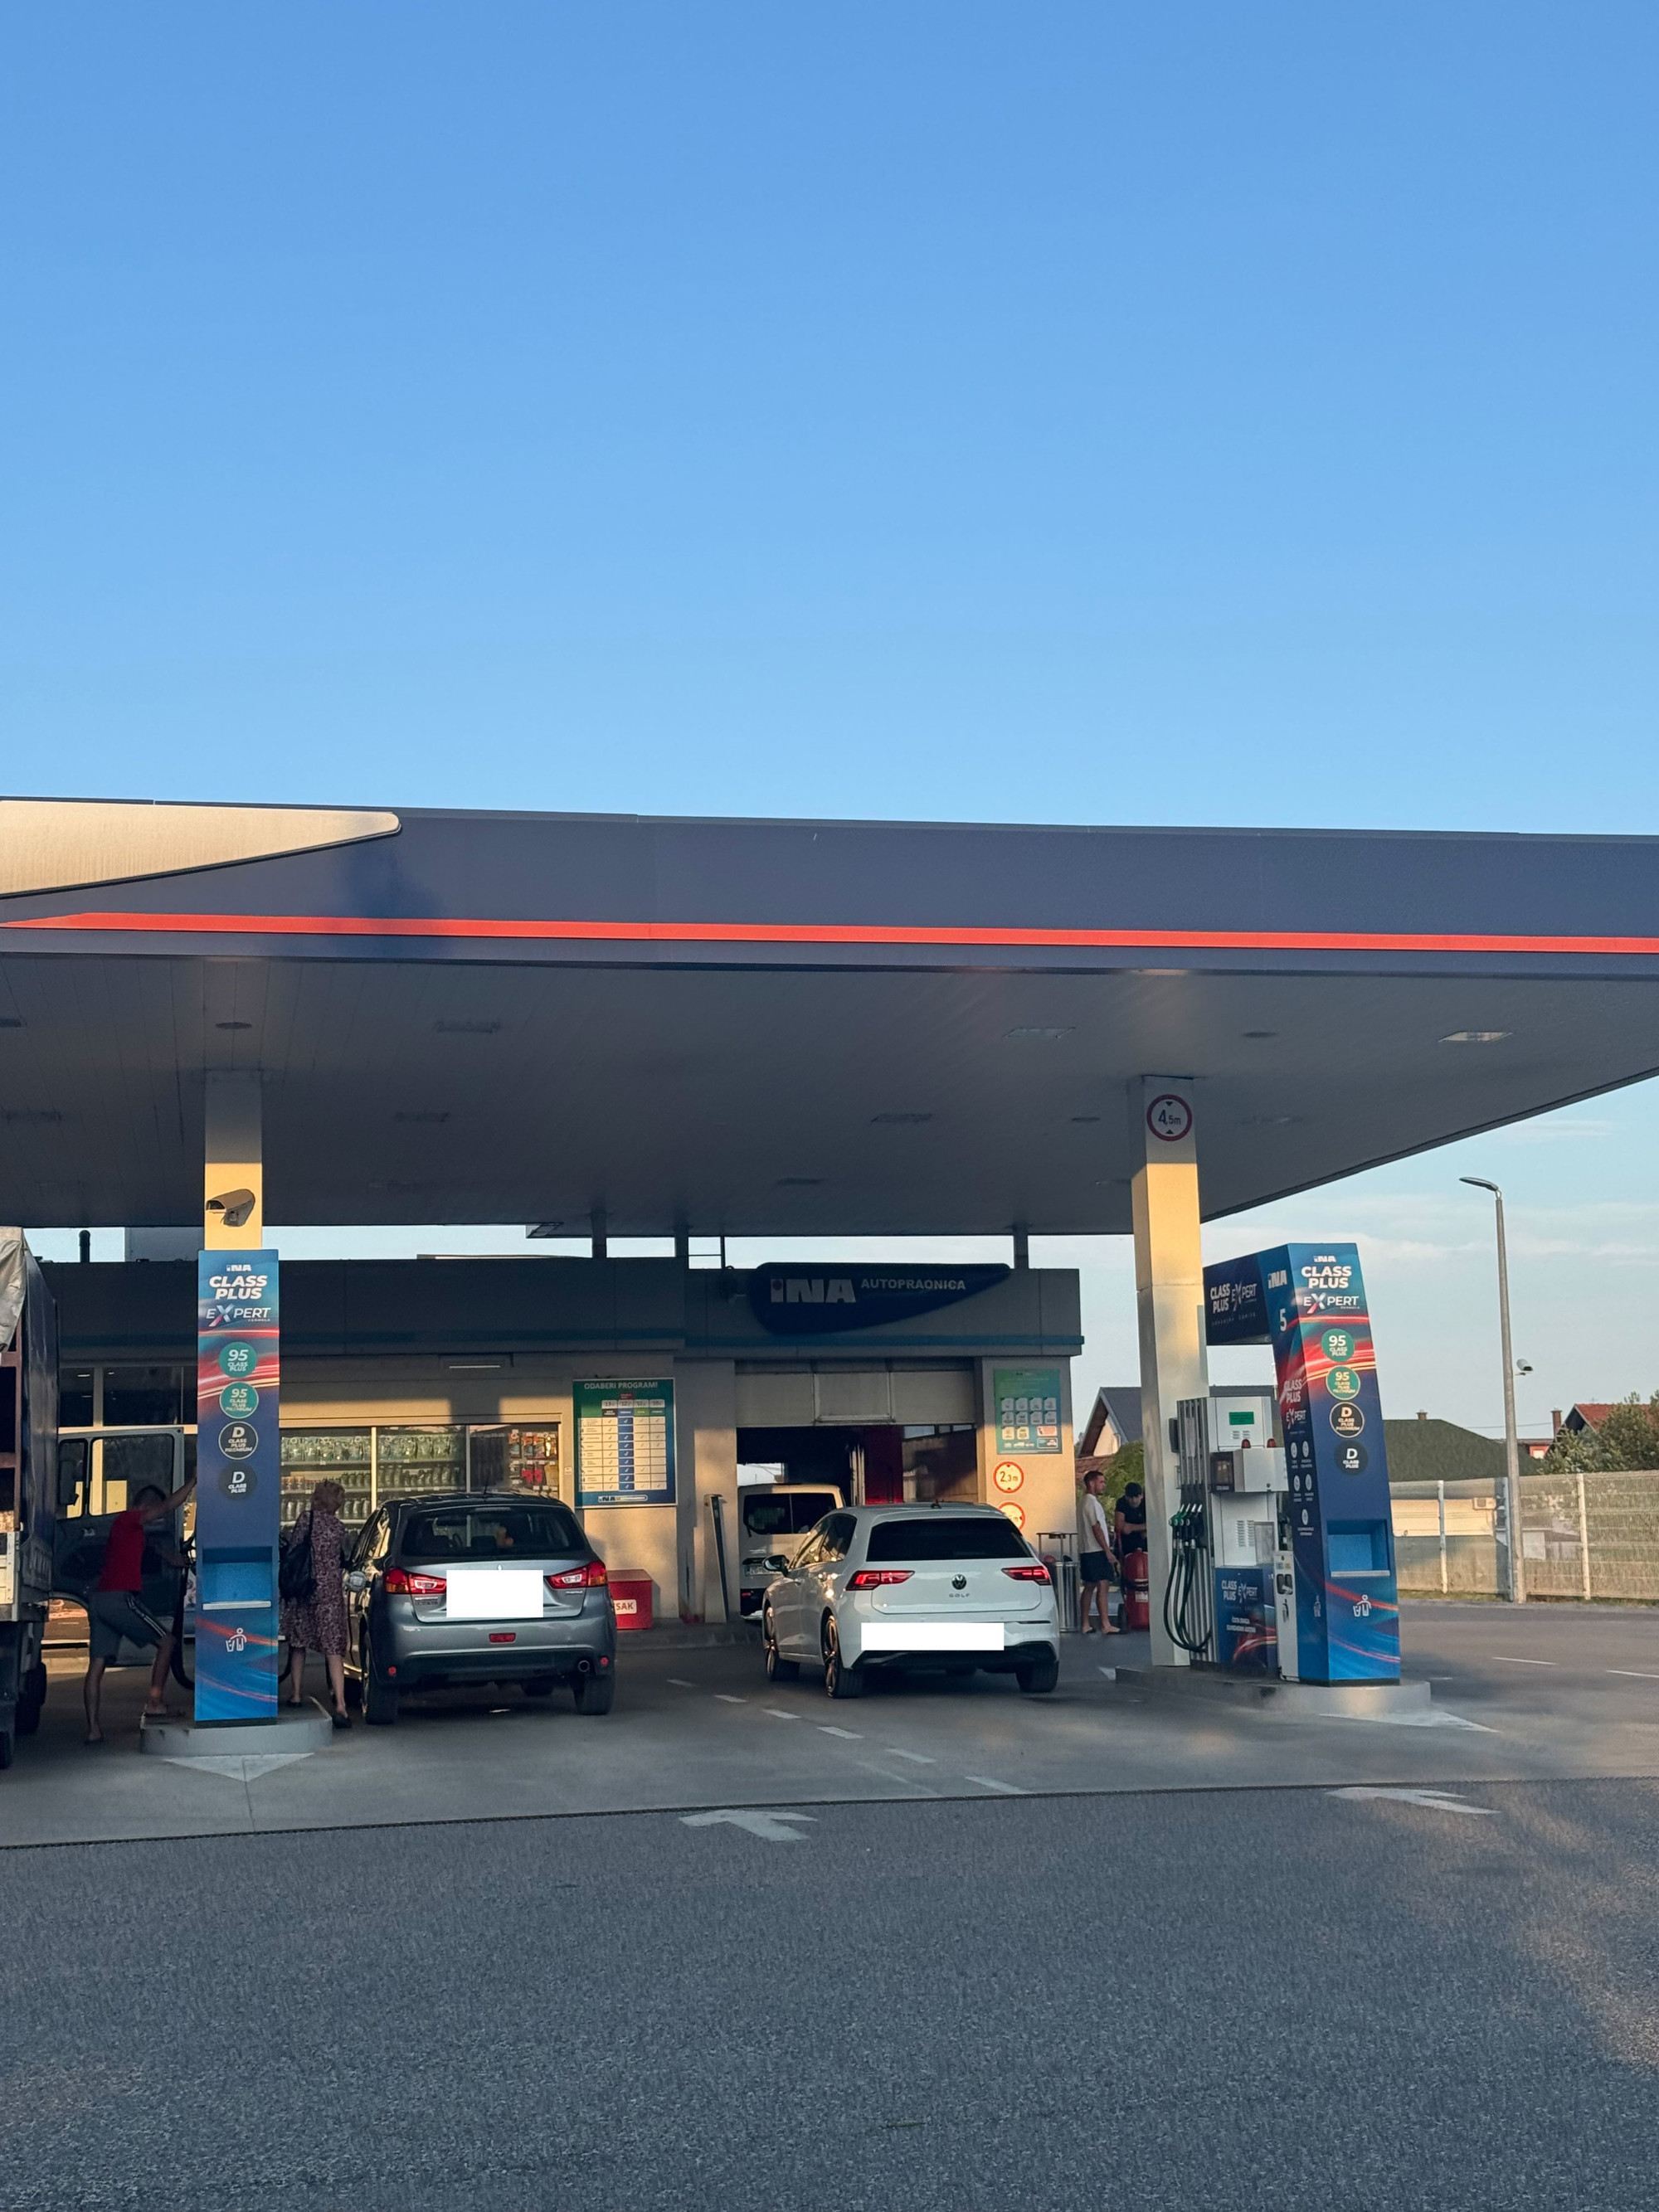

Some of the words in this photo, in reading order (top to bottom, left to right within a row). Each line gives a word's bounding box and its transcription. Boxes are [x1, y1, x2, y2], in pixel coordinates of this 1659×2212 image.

[1301, 1265, 1352, 1278] CLASS
[209, 1275, 268, 1288] CLASS
[861, 1278, 966, 1291] AUTOPRAONICA
[1308, 1277, 1349, 1290] PLUS
[215, 1287, 262, 1300] PLUS
[1210, 1282, 1231, 1300] CLASS
[1213, 1298, 1229, 1314] PLUS
[1303, 1291, 1360, 1315] EXPERT
[206, 1303, 272, 1327] EXPERT
[1279, 1308, 1287, 1332] 5
[1329, 1334, 1346, 1347] 95
[227, 1349, 249, 1362] 95
[1335, 1371, 1350, 1382] 95
[618, 1381, 659, 1389] PROGRAM!
[1284, 1378, 1302, 1391] CLASS
[231, 1388, 248, 1398] 95
[1286, 1390, 1301, 1403] PLUS
[1341, 1407, 1352, 1417] D
[232, 1427, 245, 1438] D
[1346, 1448, 1358, 1460] D
[232, 1471, 245, 1484] D
[1221, 1580, 1238, 1591] CLASS
[615, 1602, 634, 1611] SAK
